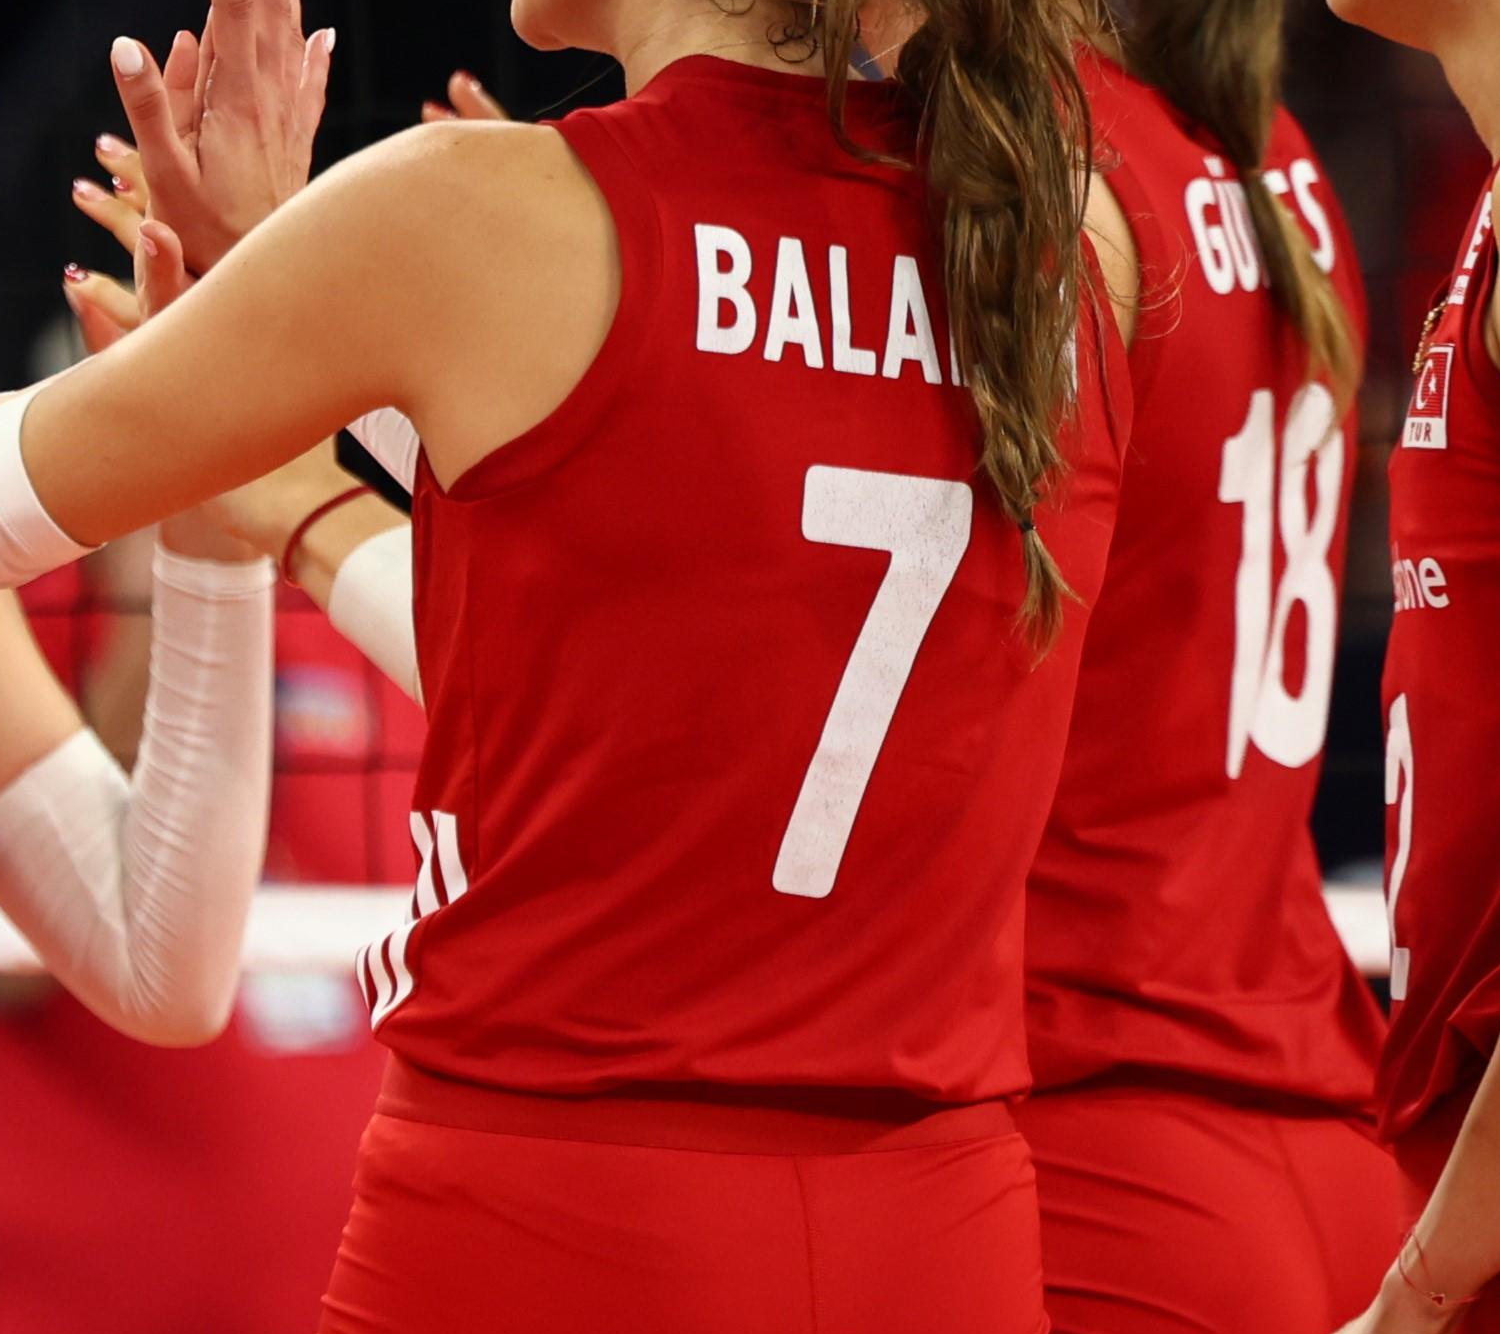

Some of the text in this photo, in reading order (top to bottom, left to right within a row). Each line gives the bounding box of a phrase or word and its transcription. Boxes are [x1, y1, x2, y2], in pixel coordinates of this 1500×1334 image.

[694, 222, 1078, 402] BALA
[1408, 421, 1433, 443] TUR
[771, 463, 974, 899] 7
[1218, 381, 1343, 779] 18
